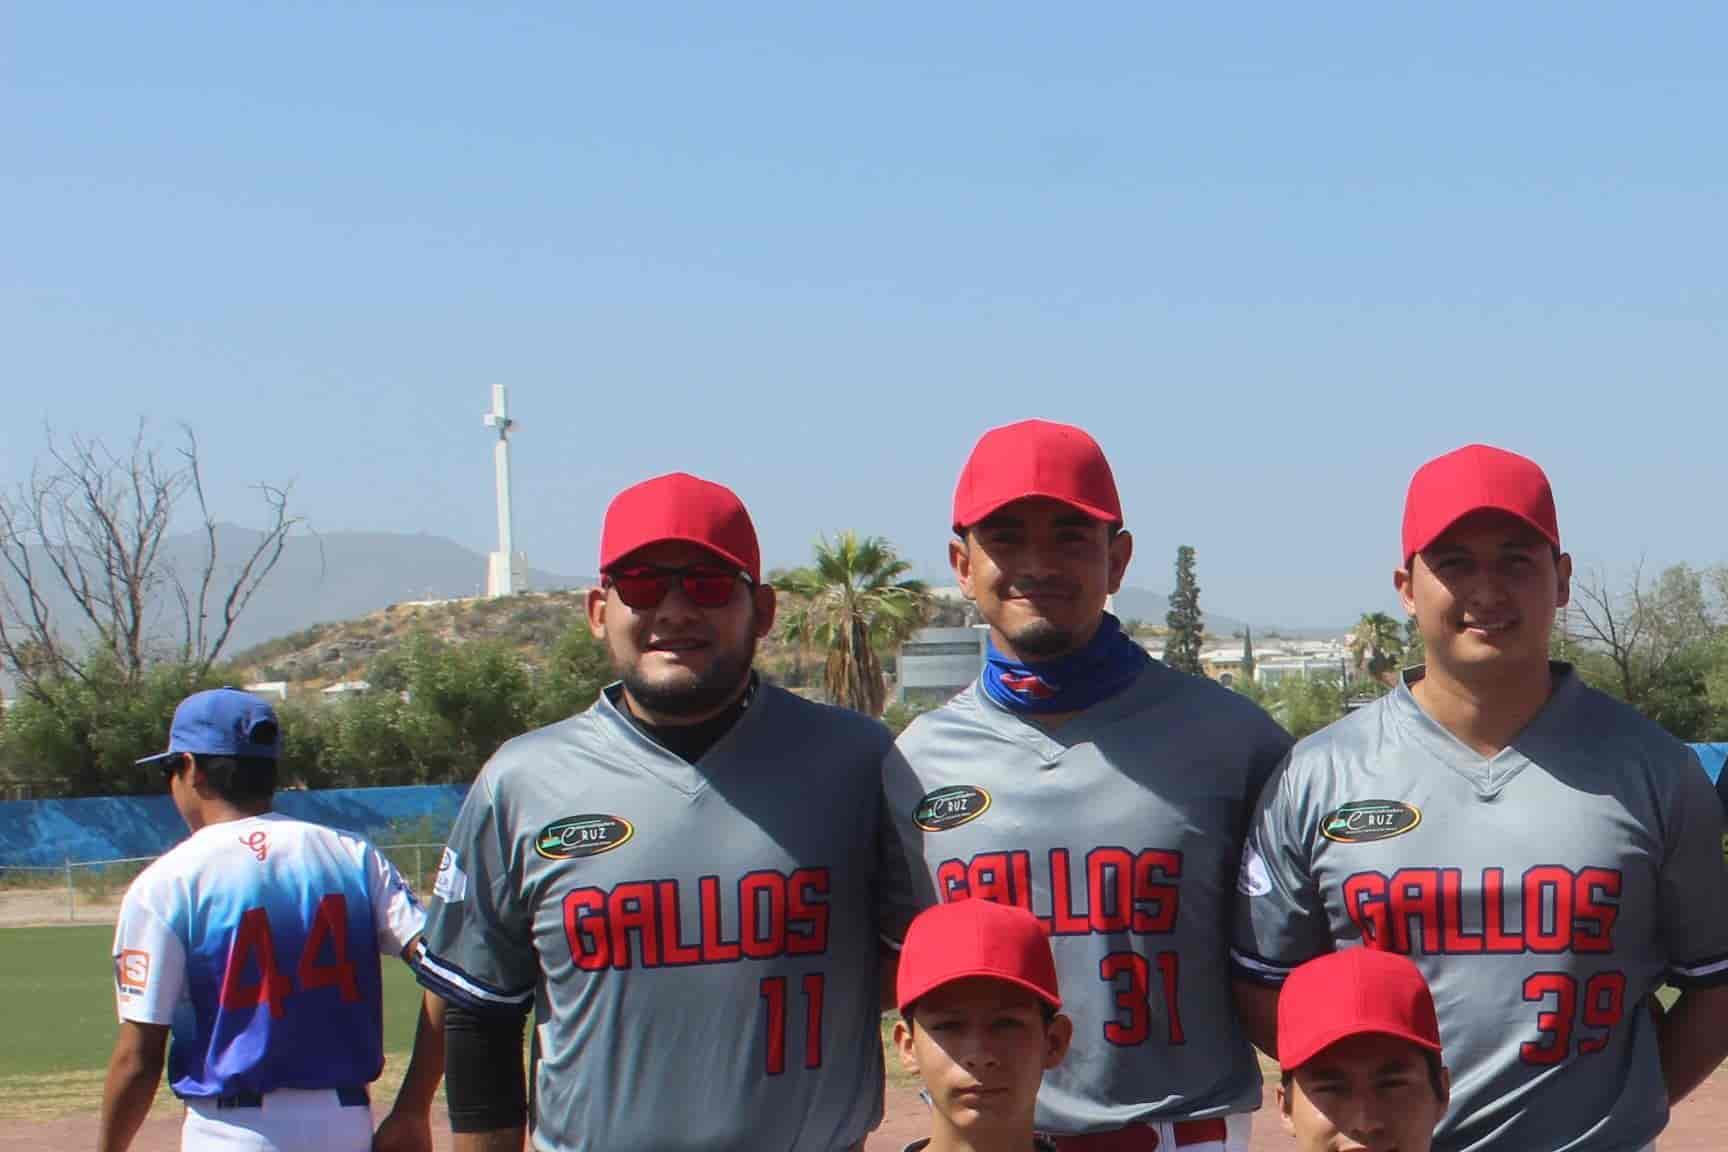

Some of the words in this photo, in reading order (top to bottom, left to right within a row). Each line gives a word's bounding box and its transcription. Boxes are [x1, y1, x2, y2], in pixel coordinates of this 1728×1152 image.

[222, 893, 365, 1021] 44
[562, 868, 831, 972] GALLOS
[1343, 865, 1622, 955] GALLOS
[760, 972, 825, 1076] 11
[1100, 951, 1186, 1047] 31
[1520, 970, 1626, 1066] 39
